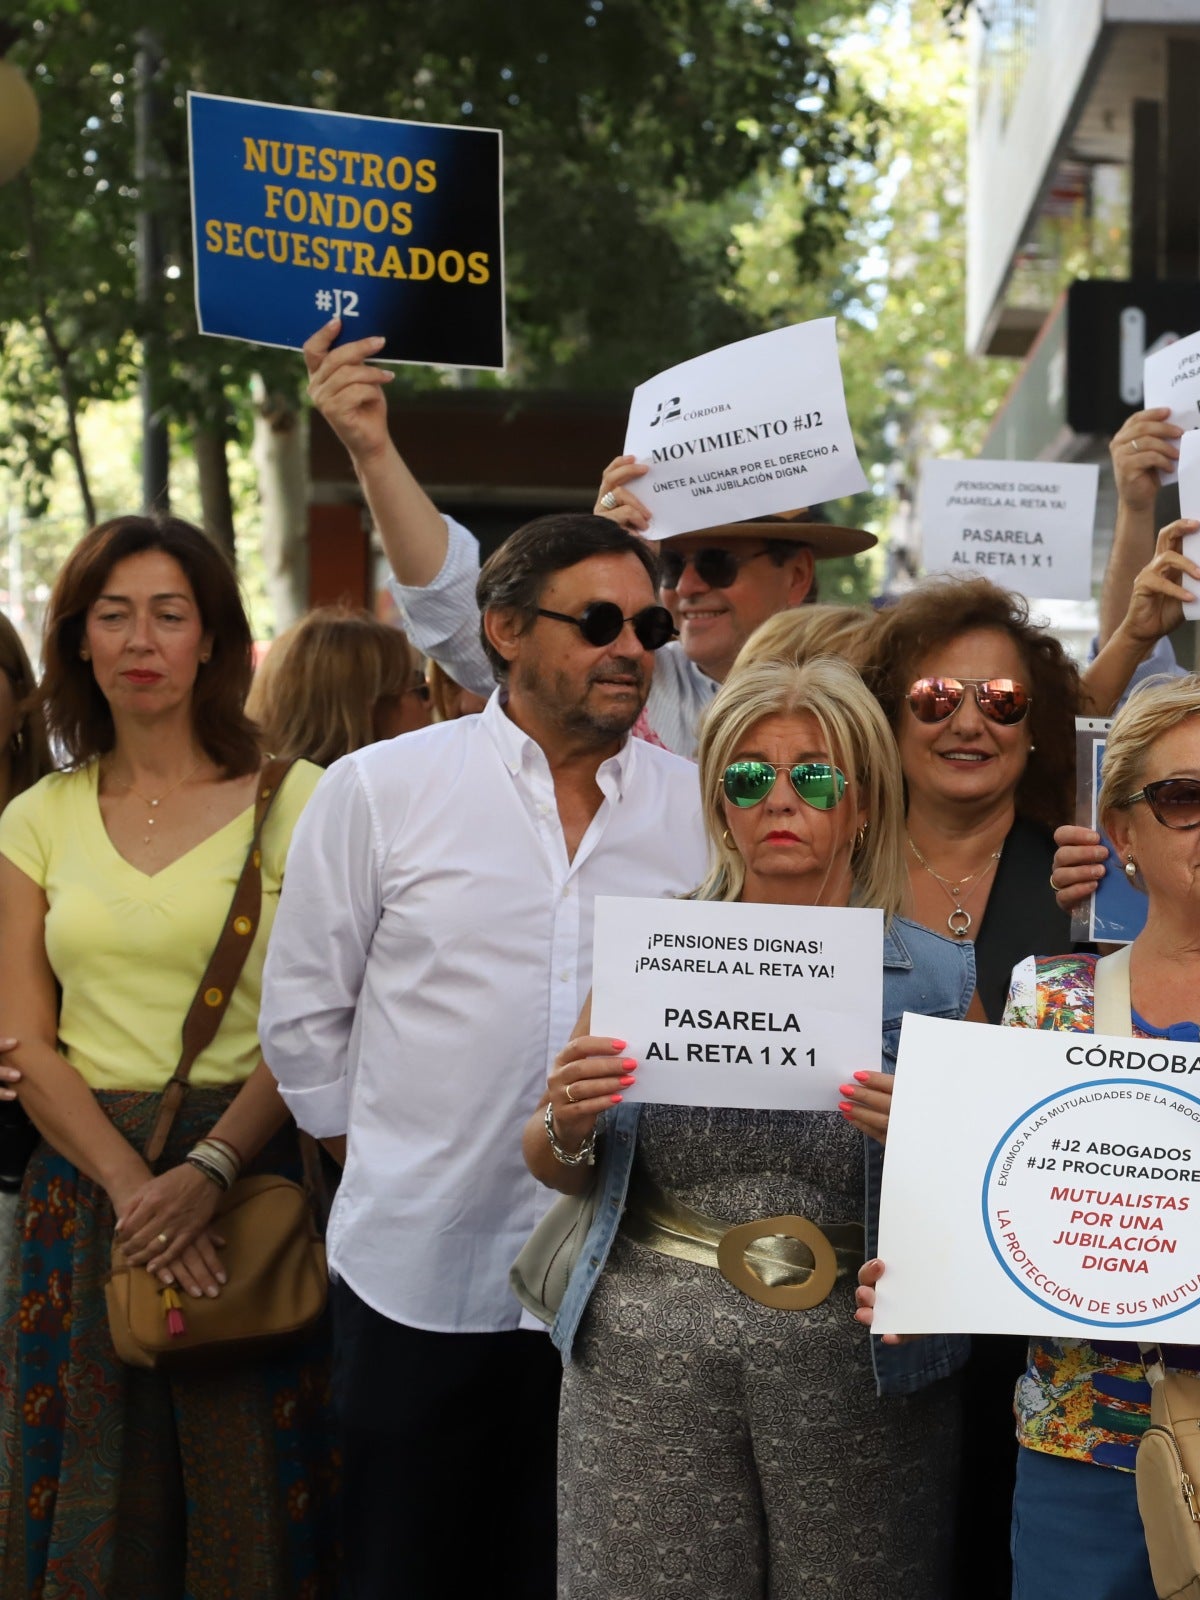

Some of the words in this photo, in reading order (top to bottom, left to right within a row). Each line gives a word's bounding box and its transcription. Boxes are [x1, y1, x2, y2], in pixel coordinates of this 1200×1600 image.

[243, 136, 437, 193] NUESTROS
[264, 185, 413, 236] FONDOS
[205, 219, 490, 285] SECUESTRADOS
[315, 289, 359, 317] #J2
[683, 403, 731, 421] CÓRDOBA
[652, 419, 788, 464] MOVIMIENTO
[794, 411, 823, 431] #J2
[653, 473, 687, 493] ÚNETE
[689, 476, 697, 485] A
[698, 467, 738, 483] LUCHAR
[740, 462, 762, 473] POR
[765, 459, 778, 468] EL
[780, 448, 828, 464] DERECHO
[831, 444, 839, 453] A
[691, 484, 713, 497] UNA
[716, 472, 774, 492] JUBILACIÓN
[776, 464, 808, 480] DIGNA
[1018, 483, 1060, 493] DIGNAS!
[1004, 499, 1017, 507] AL
[1020, 499, 1047, 508] RETA
[1050, 501, 1066, 509] YA!
[963, 529, 1043, 544] PASARELA
[952, 551, 970, 563] AL
[976, 552, 1016, 565] RETA
[1021, 555, 1026, 565] 1
[1032, 555, 1041, 567] X
[1047, 556, 1052, 567] 1
[648, 933, 748, 950] ¡PENSIONES
[753, 939, 823, 954] DIGNAS!
[635, 957, 728, 973] ¡PASARELA
[732, 962, 754, 975] AL
[759, 963, 802, 977] RETA
[808, 964, 834, 978] YA!
[664, 1008, 801, 1032] PASARELA
[646, 1042, 678, 1061] AL
[687, 1044, 752, 1064] RETA
[760, 1047, 770, 1064] 1
[781, 1048, 796, 1066] X
[806, 1048, 816, 1066] 1
[998, 1139, 1025, 1186] EXIGIMOS
[1023, 1131, 1031, 1140] A
[1029, 1116, 1048, 1132] LAS
[1047, 1090, 1132, 1119] MUTUALIDADES
[1136, 1091, 1151, 1102] DE
[1154, 1095, 1167, 1105] LA
[1051, 1139, 1081, 1152] #J2
[1086, 1143, 1192, 1161] ABOGADOS
[1027, 1157, 1056, 1170] #J2
[1050, 1186, 1190, 1211] MUTUALISTAS
[997, 1209, 1012, 1229] LA
[1070, 1210, 1113, 1228] POR
[1119, 1214, 1164, 1231] UNA
[1053, 1230, 1177, 1253] JUBILACIÓN
[1003, 1231, 1084, 1308] PROTECCIÓN
[1081, 1256, 1149, 1274] DIGNA
[1087, 1300, 1111, 1314] DE
[1116, 1300, 1148, 1315] SUS
